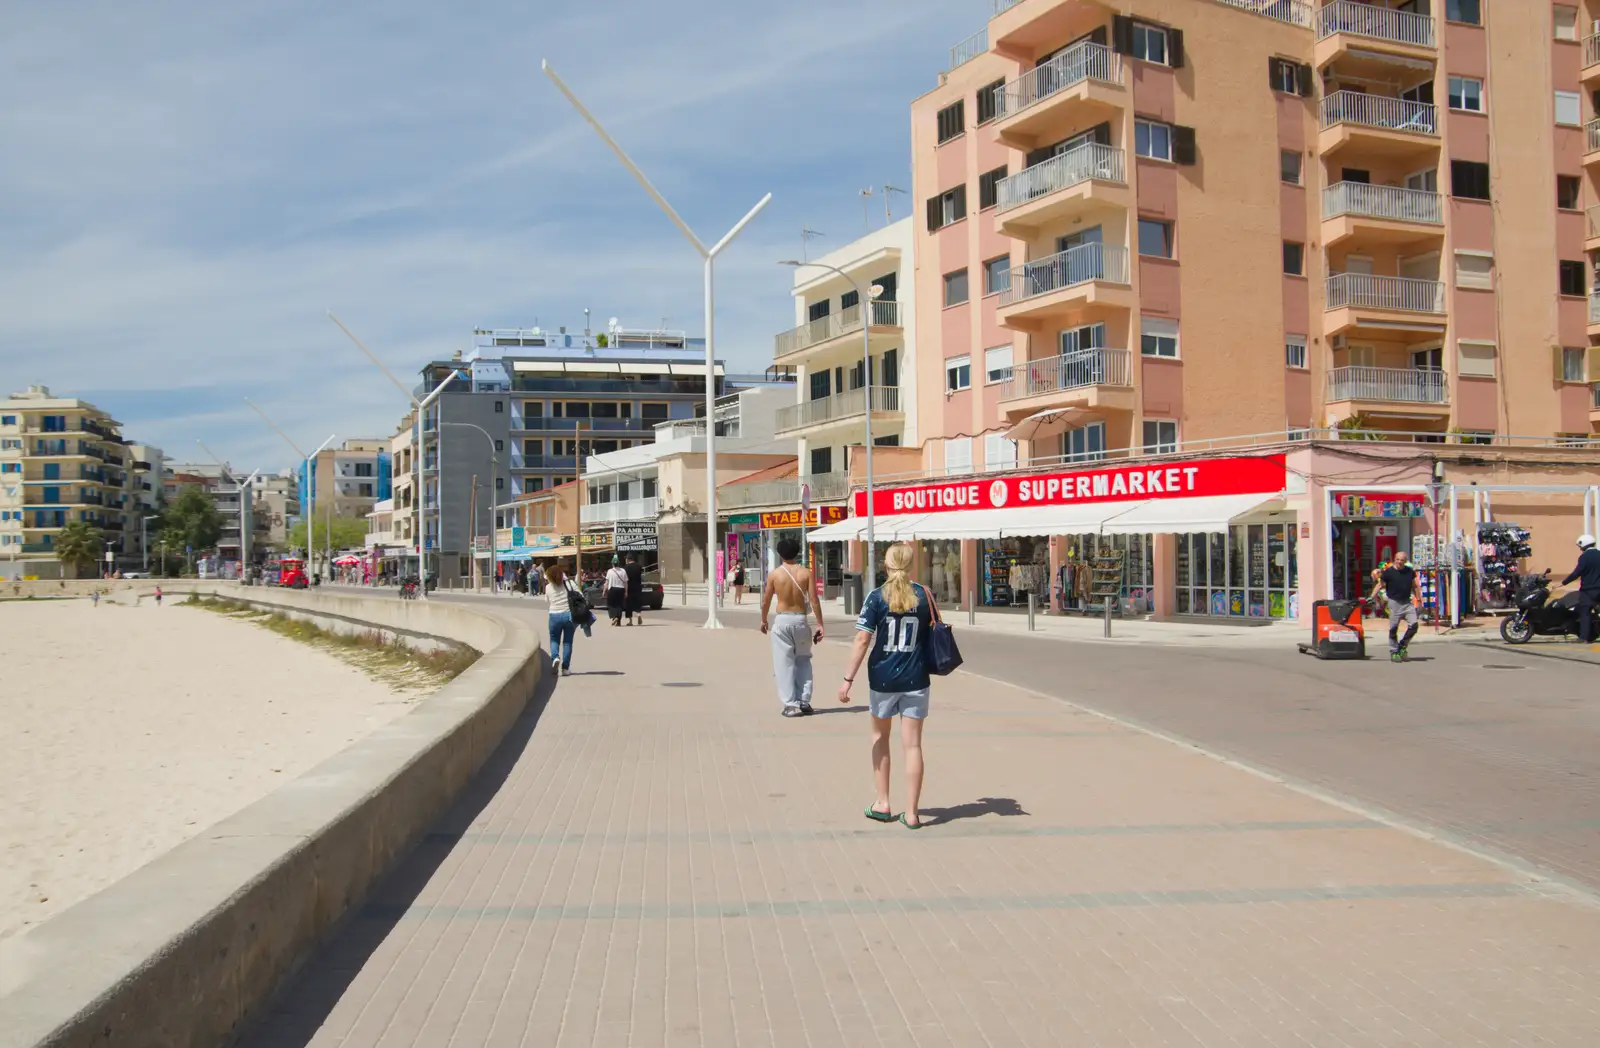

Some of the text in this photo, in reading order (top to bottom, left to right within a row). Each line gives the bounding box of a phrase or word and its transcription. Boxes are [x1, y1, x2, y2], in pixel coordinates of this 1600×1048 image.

[1018, 467, 1199, 501] SUPERMARKET
[893, 485, 980, 510] BOUTIQUE
[772, 509, 818, 523] TABAC
[616, 536, 643, 544] PAELLAS
[883, 616, 919, 652] 10
